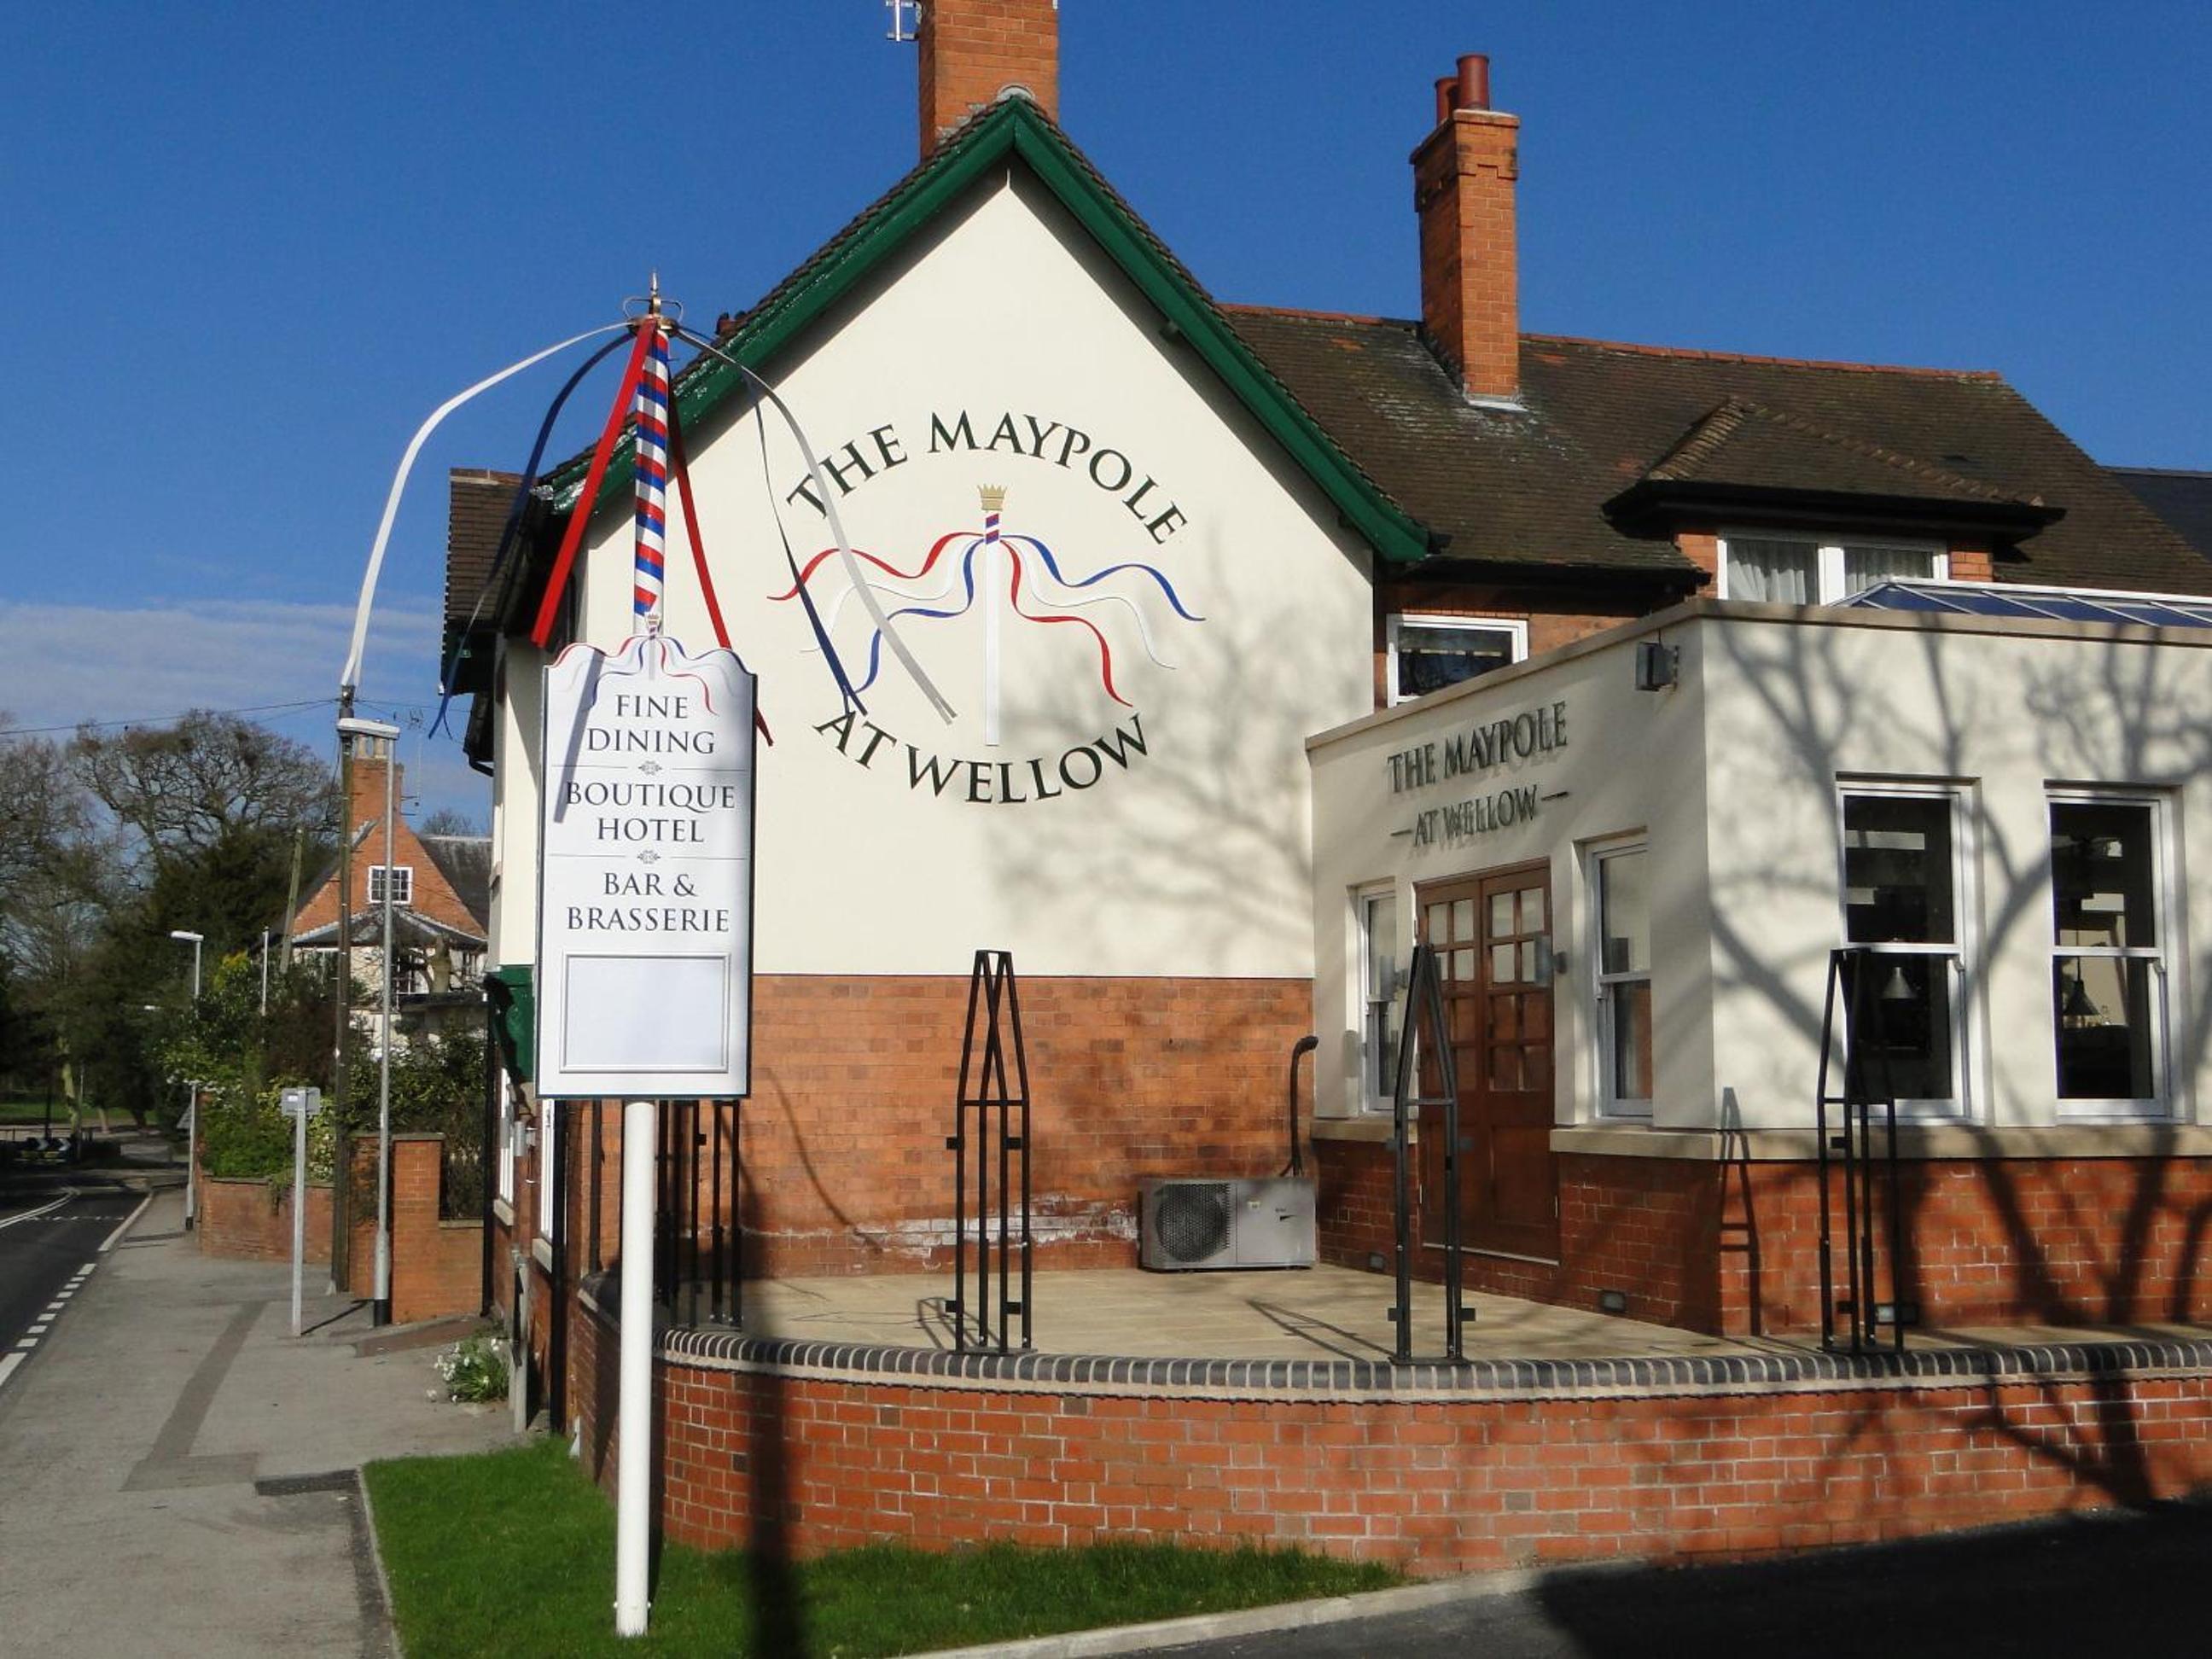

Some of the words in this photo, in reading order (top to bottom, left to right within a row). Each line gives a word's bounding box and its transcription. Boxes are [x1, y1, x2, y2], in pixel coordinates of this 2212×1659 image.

[786, 423, 908, 519] THE
[927, 410, 1188, 544] MAYPOLE
[614, 695, 688, 719] FINE
[587, 728, 715, 754] DINING
[1388, 743, 1435, 793] THE
[1444, 701, 1568, 779] MAYPOLE
[812, 710, 897, 769] AT
[905, 713, 1148, 805] WELLOW
[565, 782, 735, 812] BOUTIQUE
[1414, 810, 1438, 847] AT
[1442, 784, 1537, 841] WELLOW
[597, 818, 704, 843] HOTEL
[603, 872, 663, 896] BAR
[673, 873, 696, 897] &
[567, 907, 730, 933] BRASSERIE
